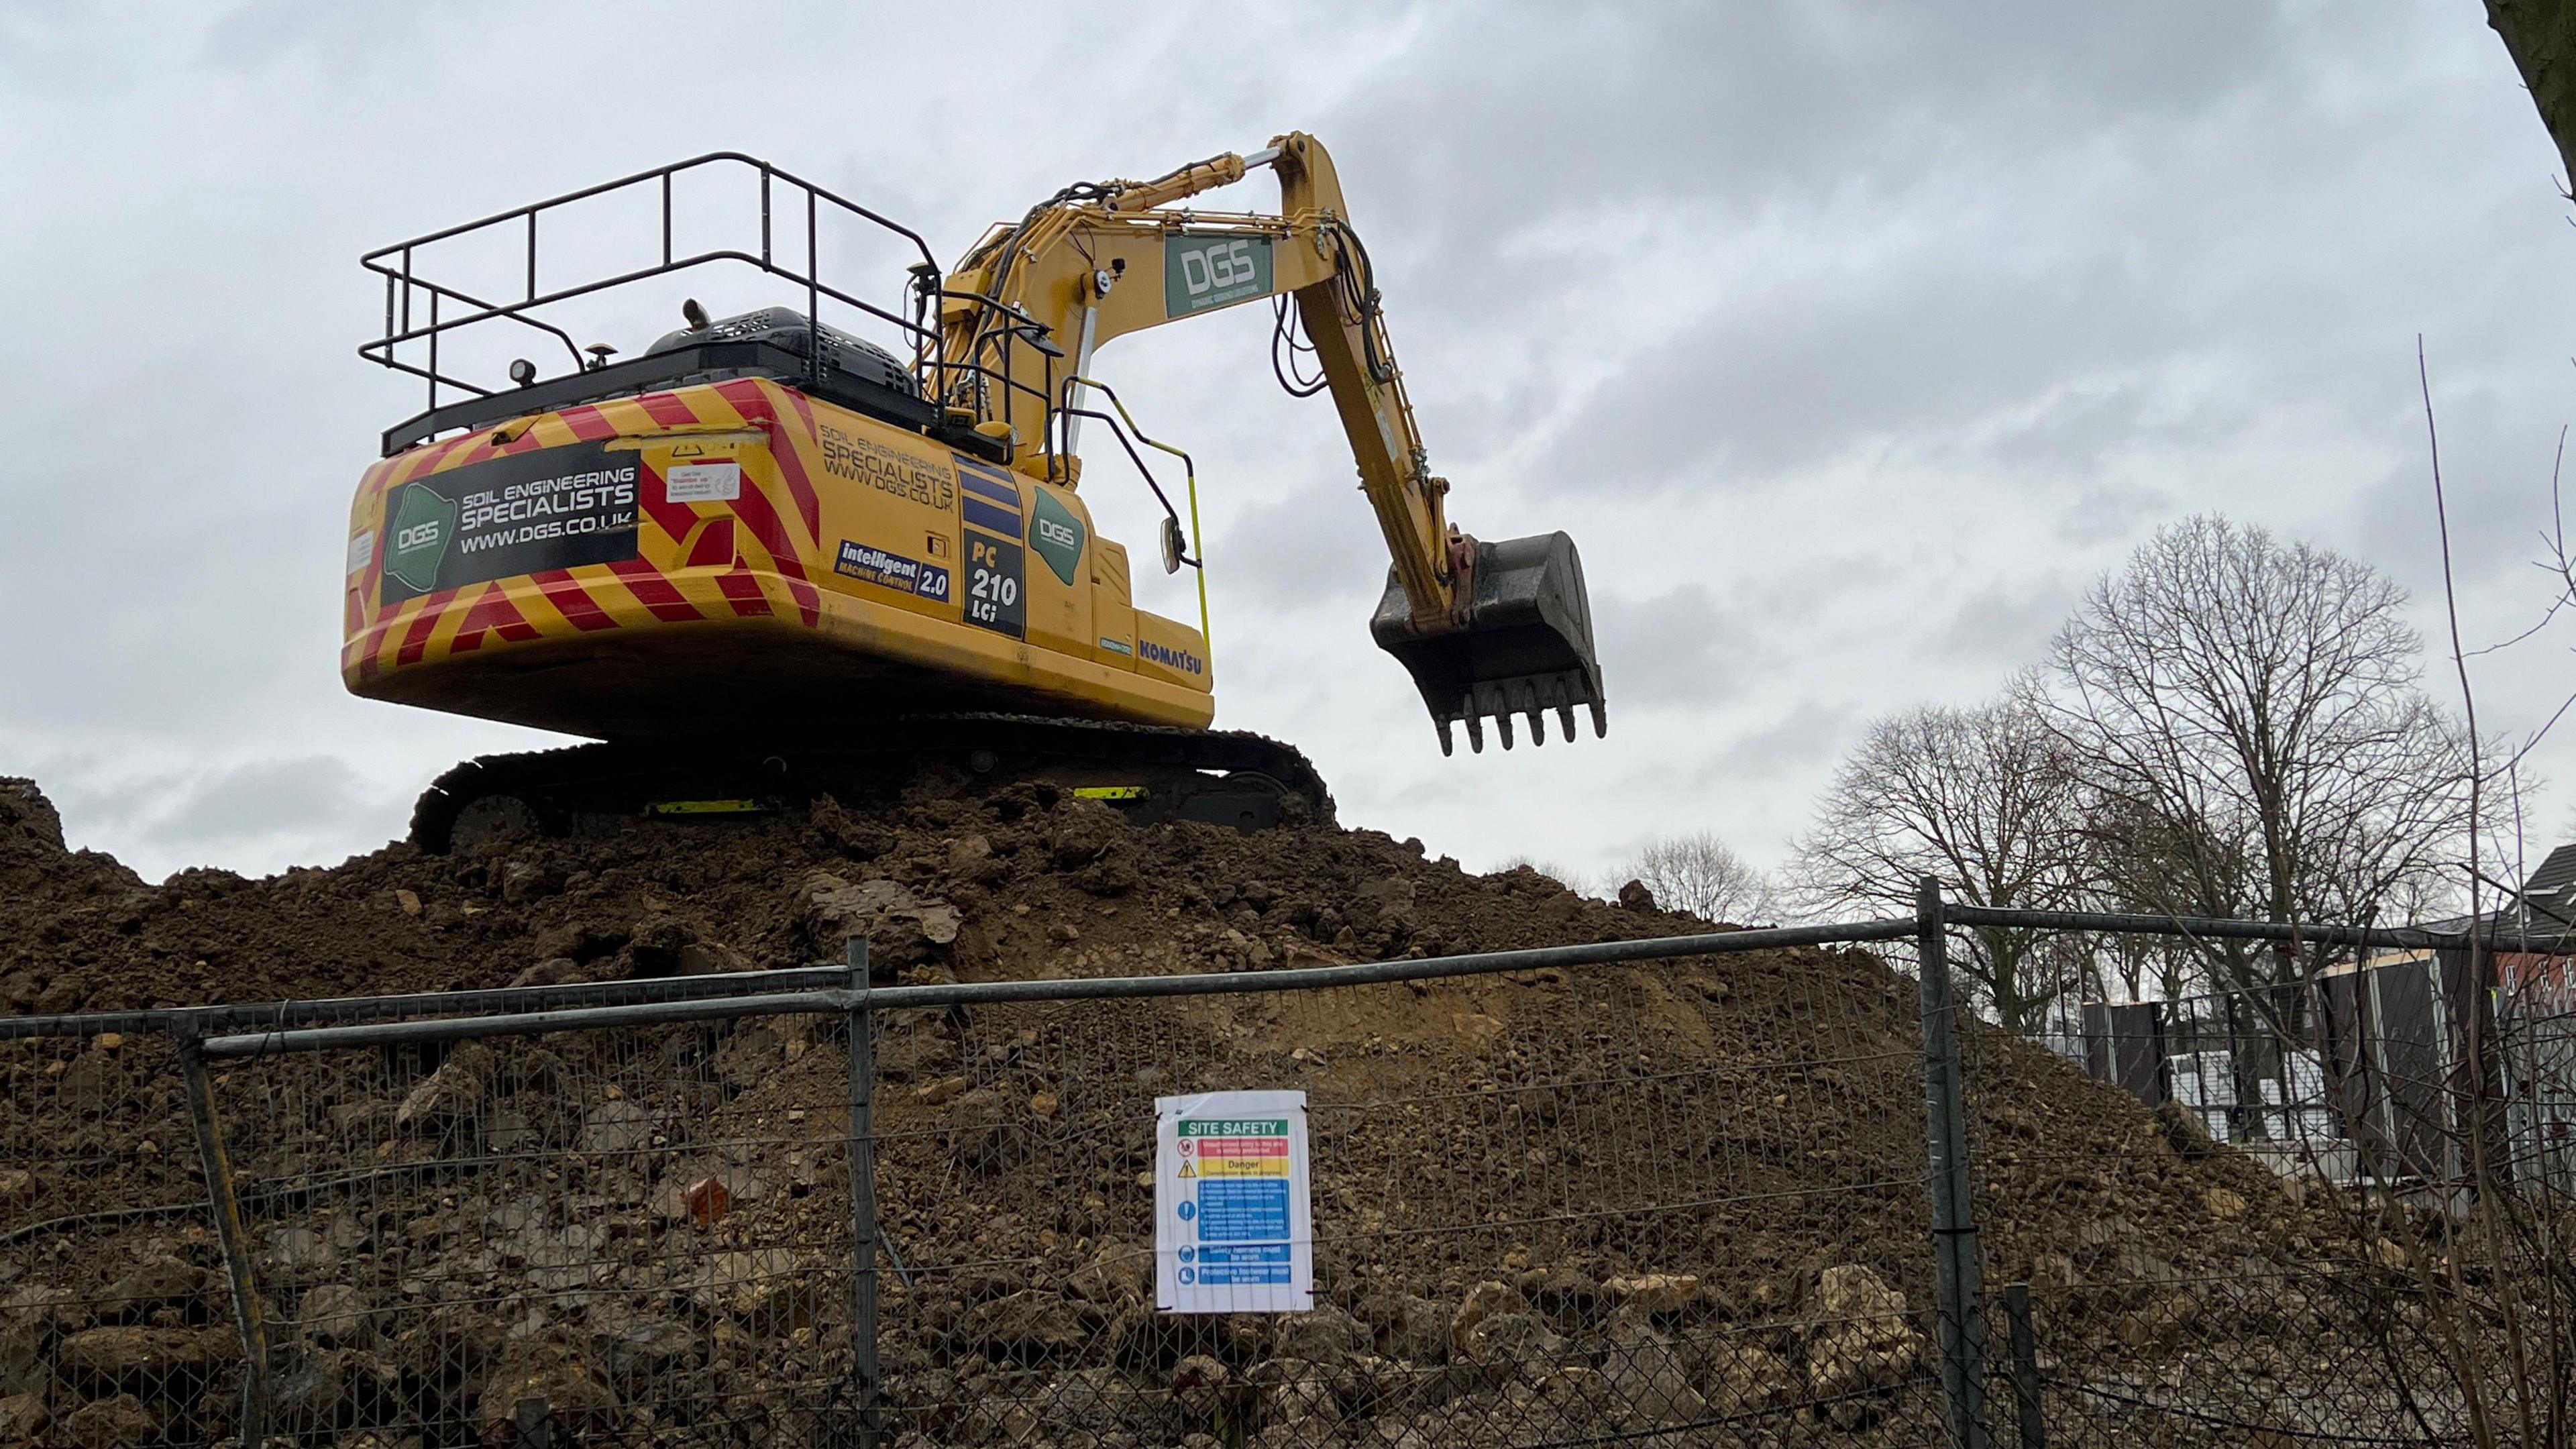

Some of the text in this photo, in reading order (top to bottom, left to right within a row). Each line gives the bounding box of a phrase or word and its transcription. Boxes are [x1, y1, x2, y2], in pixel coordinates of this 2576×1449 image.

[1181, 239, 1256, 295] DGS
[820, 425, 952, 480] SOIL ENGINEERING
[823, 440, 953, 498] SPECIALISTS
[462, 467, 635, 510] SOIL ENGINEERING
[824, 458, 953, 514] WWW.DGS.CO.UK
[461, 484, 634, 531] SPECIALISTS
[398, 520, 439, 549] DGS
[461, 512, 633, 554] WWW.DGS.CO.UK
[1039, 518, 1075, 546] DGS
[842, 542, 917, 578] intelligent
[971, 541, 998, 568] PC
[839, 561, 913, 592] MACHINE CONTROL
[920, 570, 947, 596] 2.0
[971, 568, 1017, 606] 210
[971, 600, 998, 623] LCi
[1140, 639, 1201, 675] KOMATSU
[1188, 1121, 1277, 1134] SITE SAFETY
[1228, 1160, 1259, 1170] Danger
